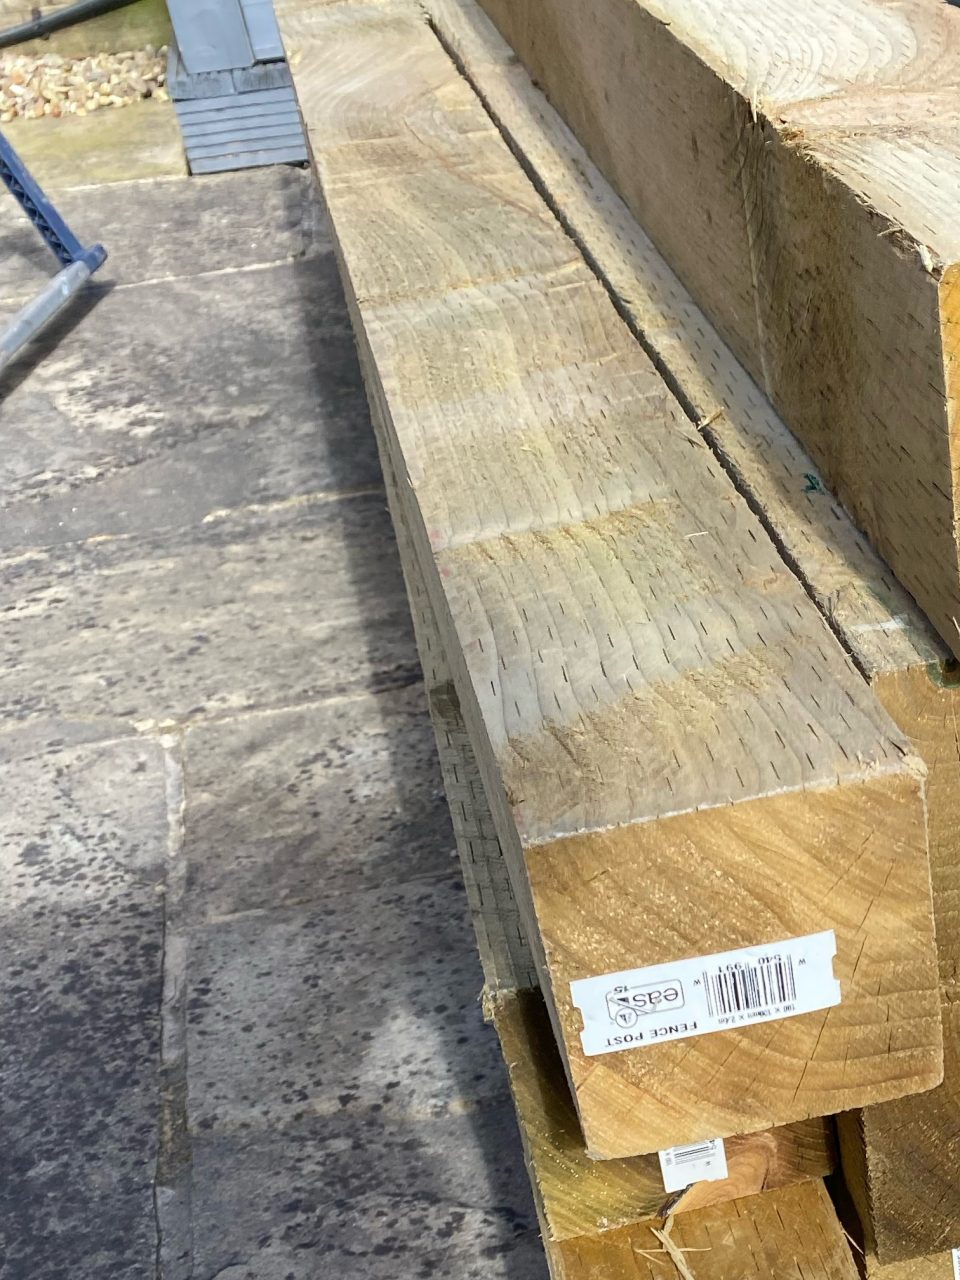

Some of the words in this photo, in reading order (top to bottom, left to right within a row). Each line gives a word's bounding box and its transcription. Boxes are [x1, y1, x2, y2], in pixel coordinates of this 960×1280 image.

[758, 954, 781, 964] 540
[718, 963, 741, 973] 991
[613, 985, 628, 993] 15
[651, 1021, 697, 1037] FENCE
[605, 1032, 643, 1047] POST
